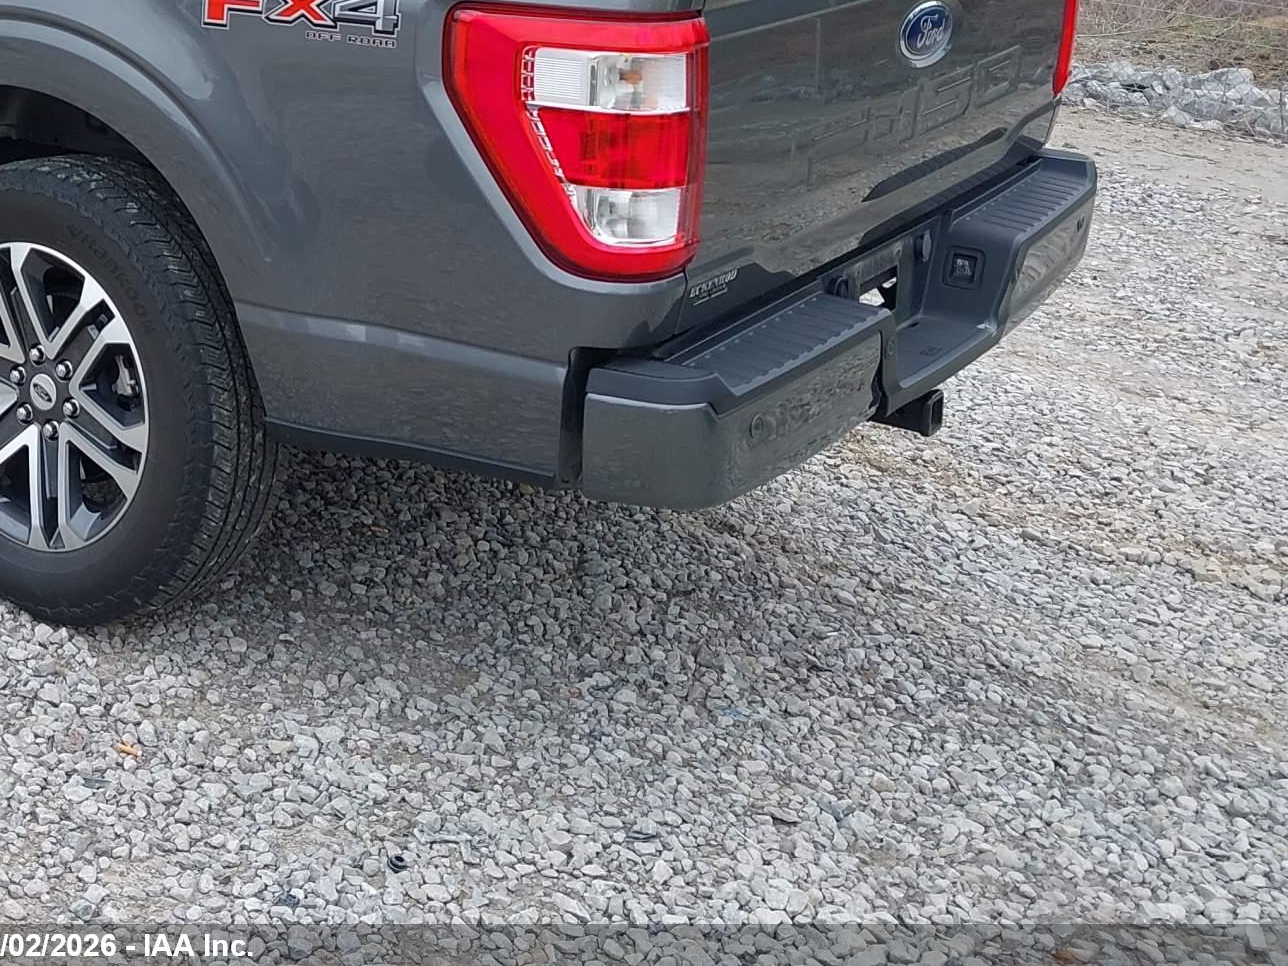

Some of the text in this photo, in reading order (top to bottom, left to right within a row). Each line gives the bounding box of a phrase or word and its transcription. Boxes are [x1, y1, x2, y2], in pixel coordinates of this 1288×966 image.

[306, 30, 397, 49] OFF ROAD
[917, 14, 946, 48] Ford
